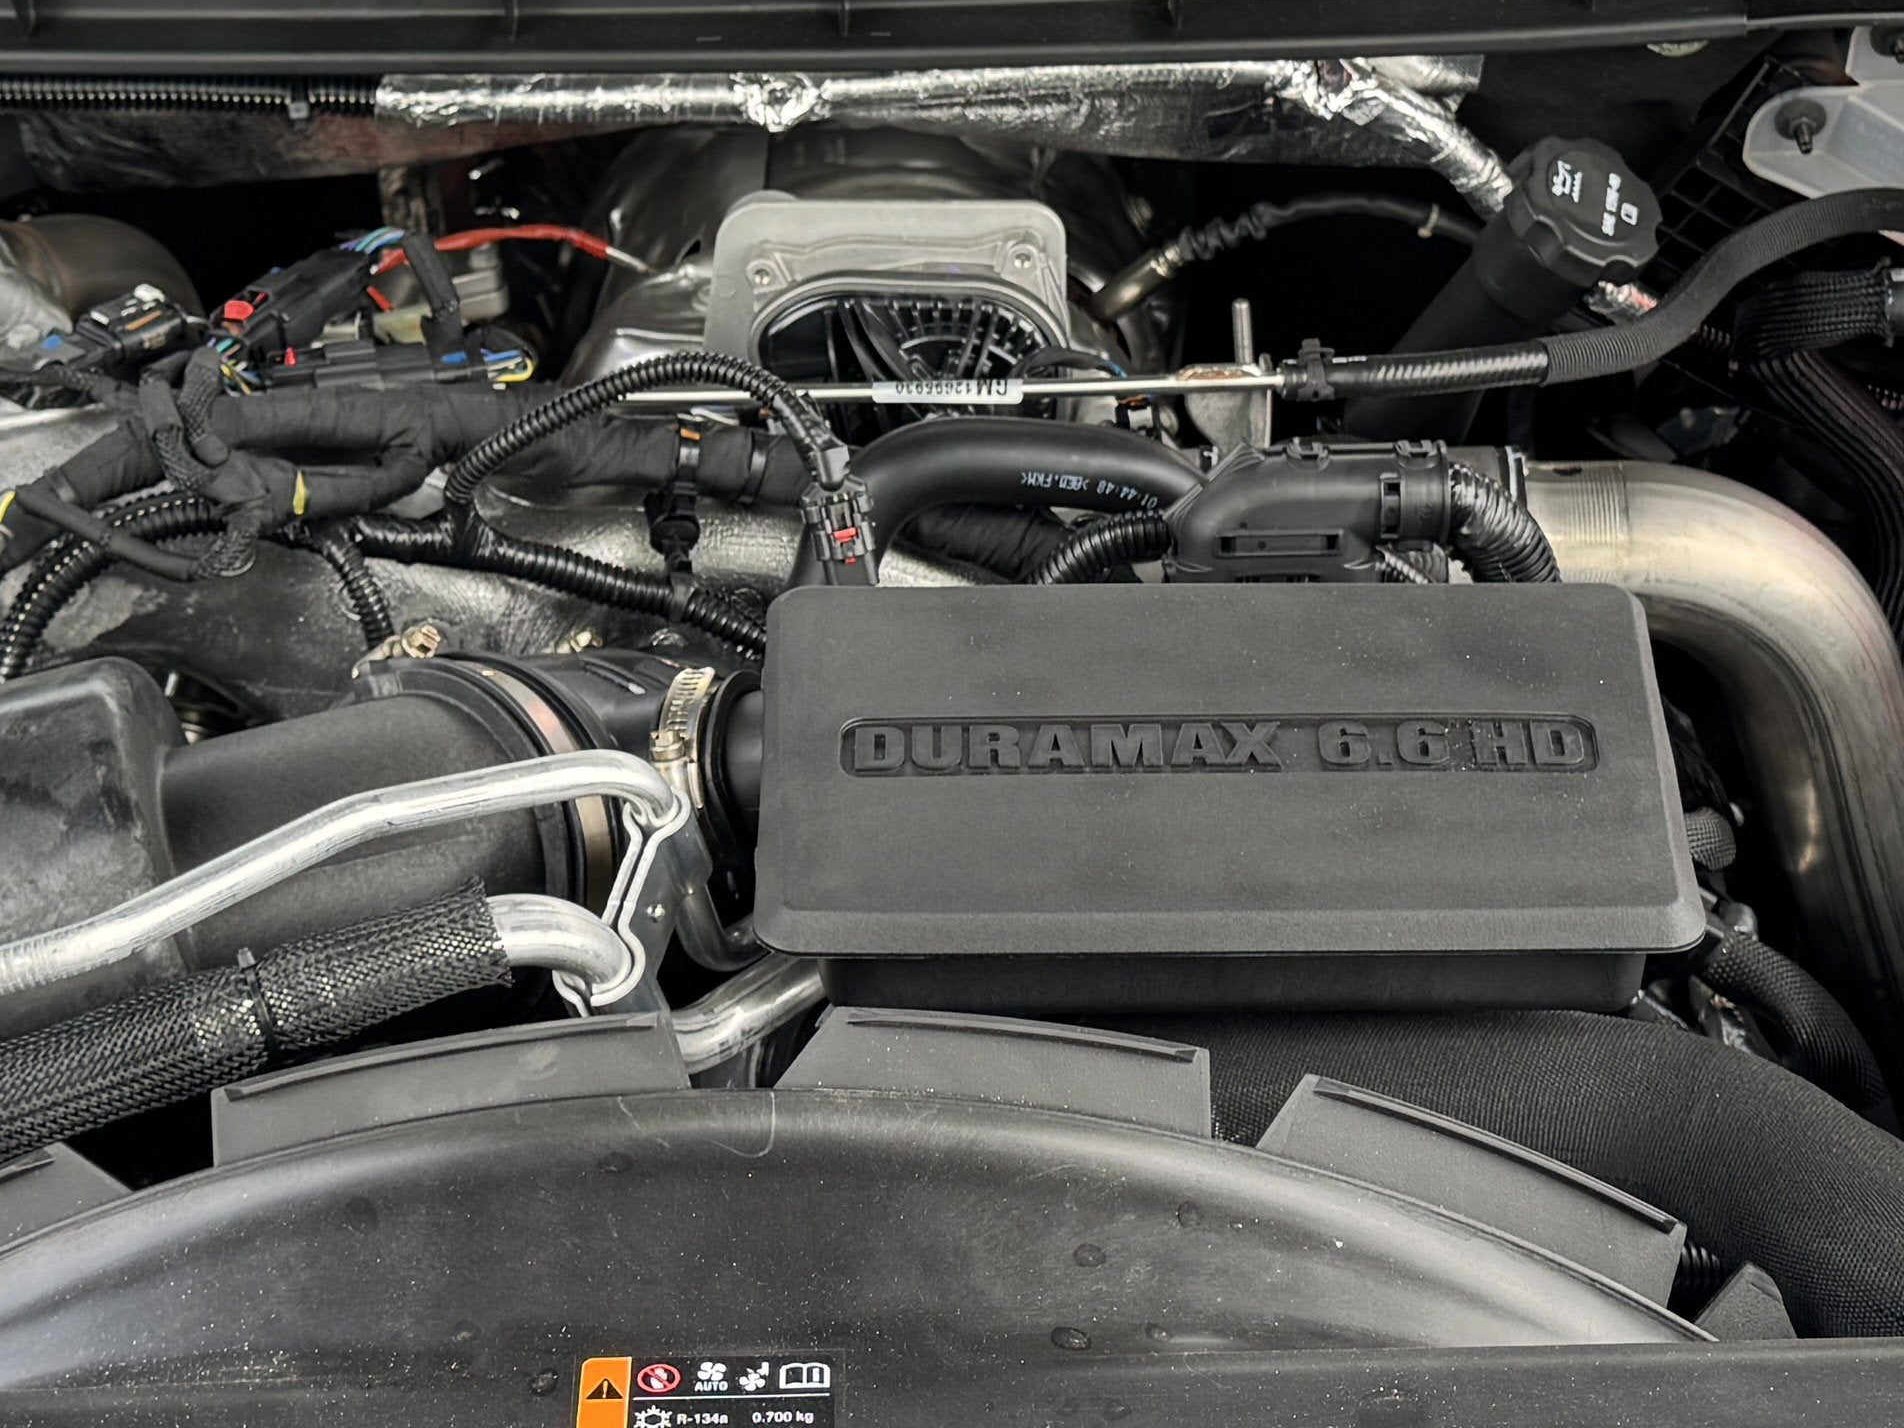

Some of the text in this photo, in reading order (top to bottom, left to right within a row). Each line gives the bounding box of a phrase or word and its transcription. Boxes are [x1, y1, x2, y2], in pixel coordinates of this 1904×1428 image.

[853, 719, 1593, 771] DURAMAX 6.6 HD
[694, 1380, 729, 1392] AUTO
[676, 1410, 815, 1425] R-134a 0.700 kg
